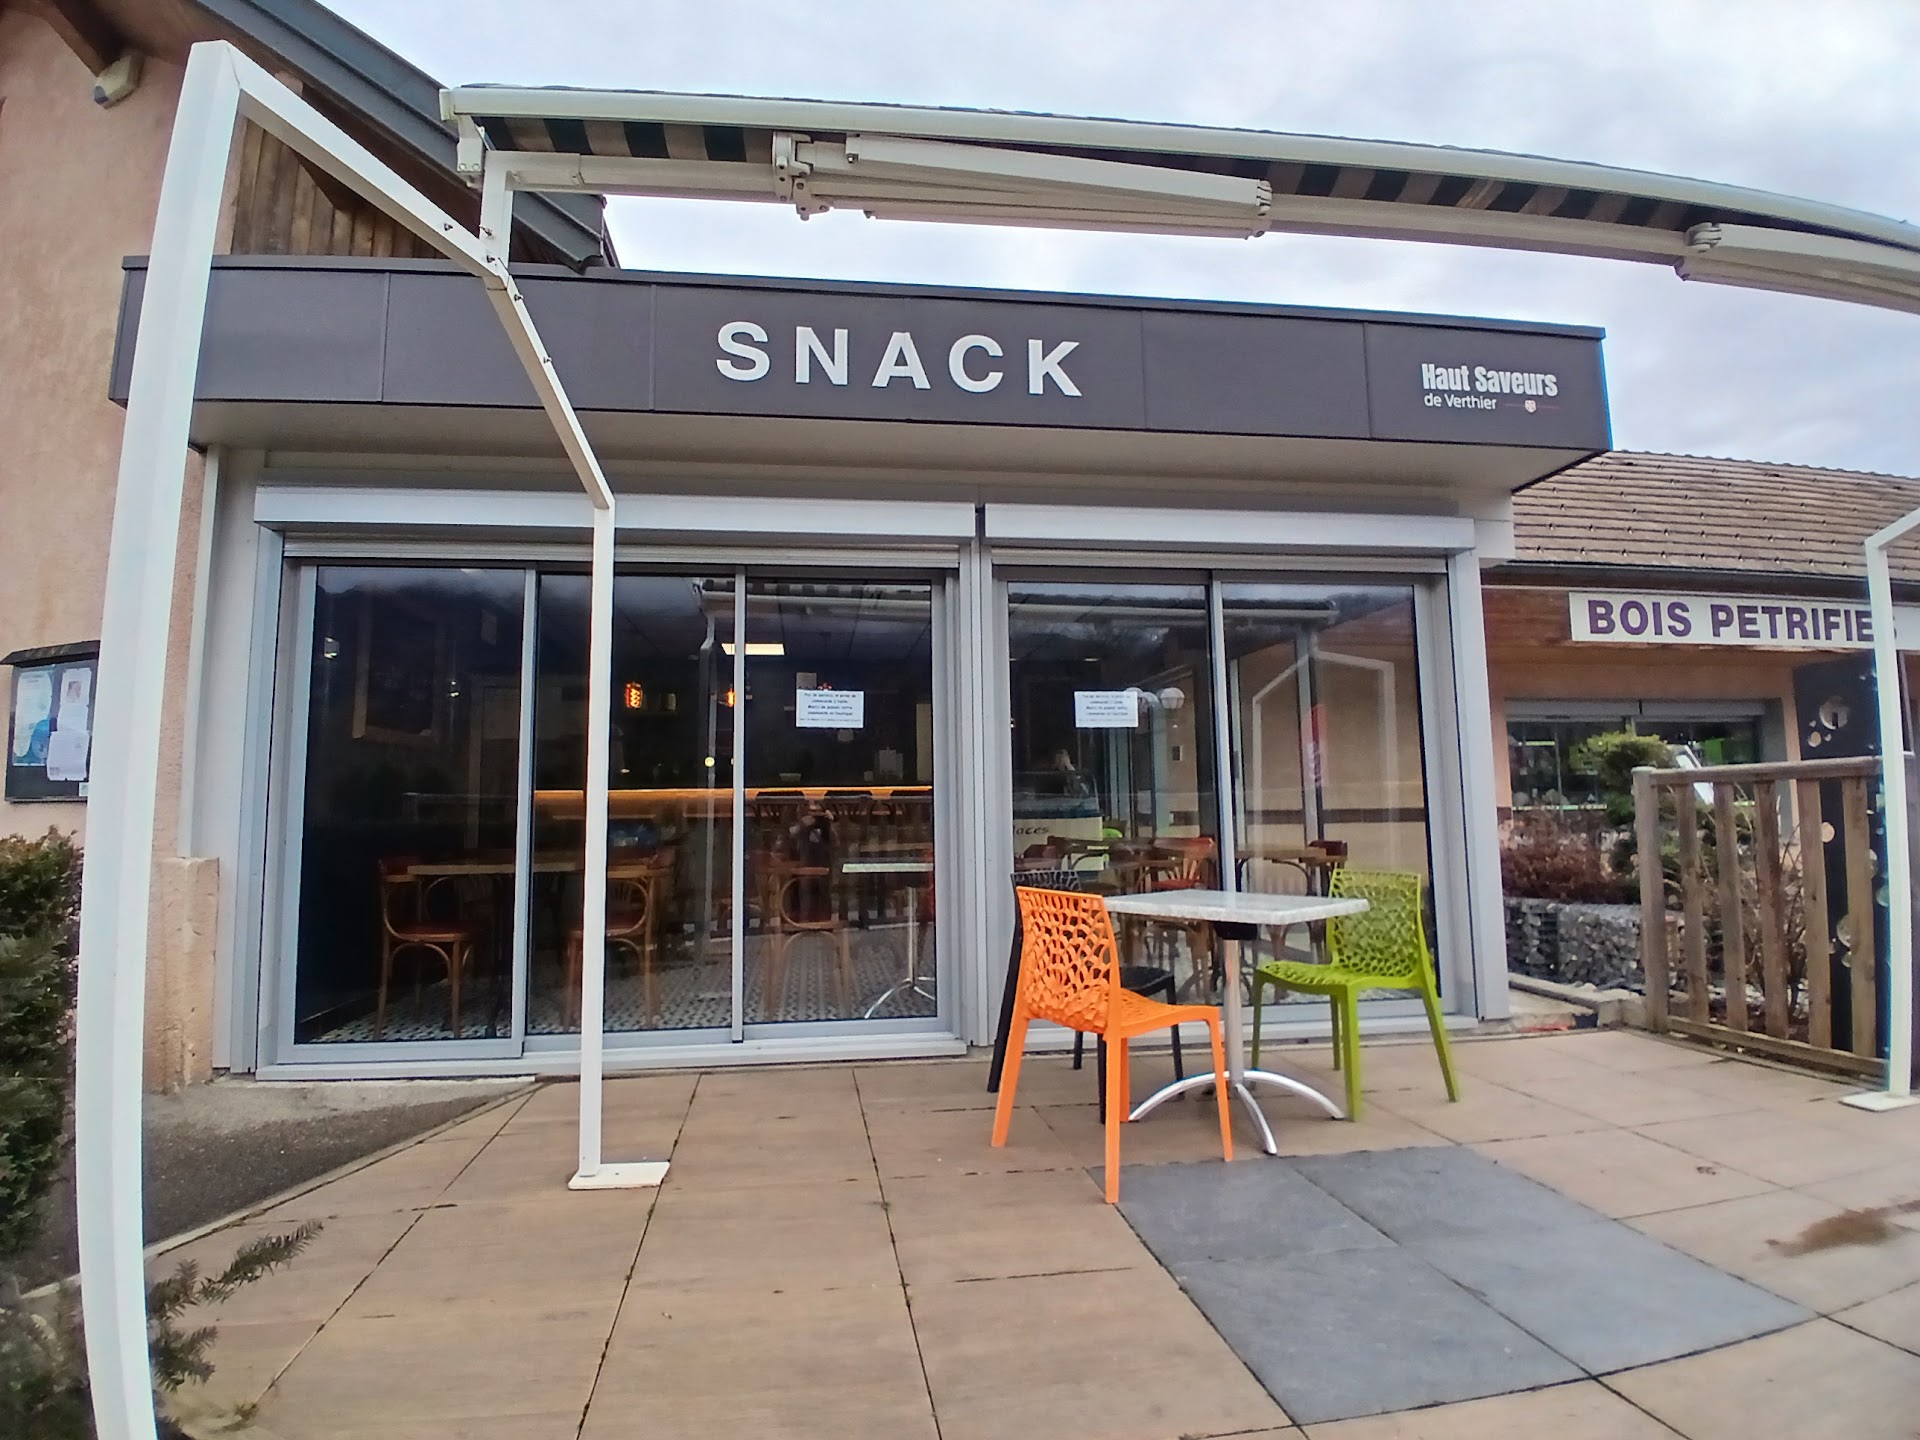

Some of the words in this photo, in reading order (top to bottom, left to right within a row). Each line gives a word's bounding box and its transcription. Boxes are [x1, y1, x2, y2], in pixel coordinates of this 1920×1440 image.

[716, 321, 1083, 398] SNACK
[1421, 363, 1471, 392] Haut
[1474, 366, 1559, 397] Saveurs
[1424, 392, 1442, 407] de
[1444, 393, 1497, 410] Verthier
[1588, 599, 1692, 637] BOIS
[1710, 604, 1897, 643] PETRIFIE
